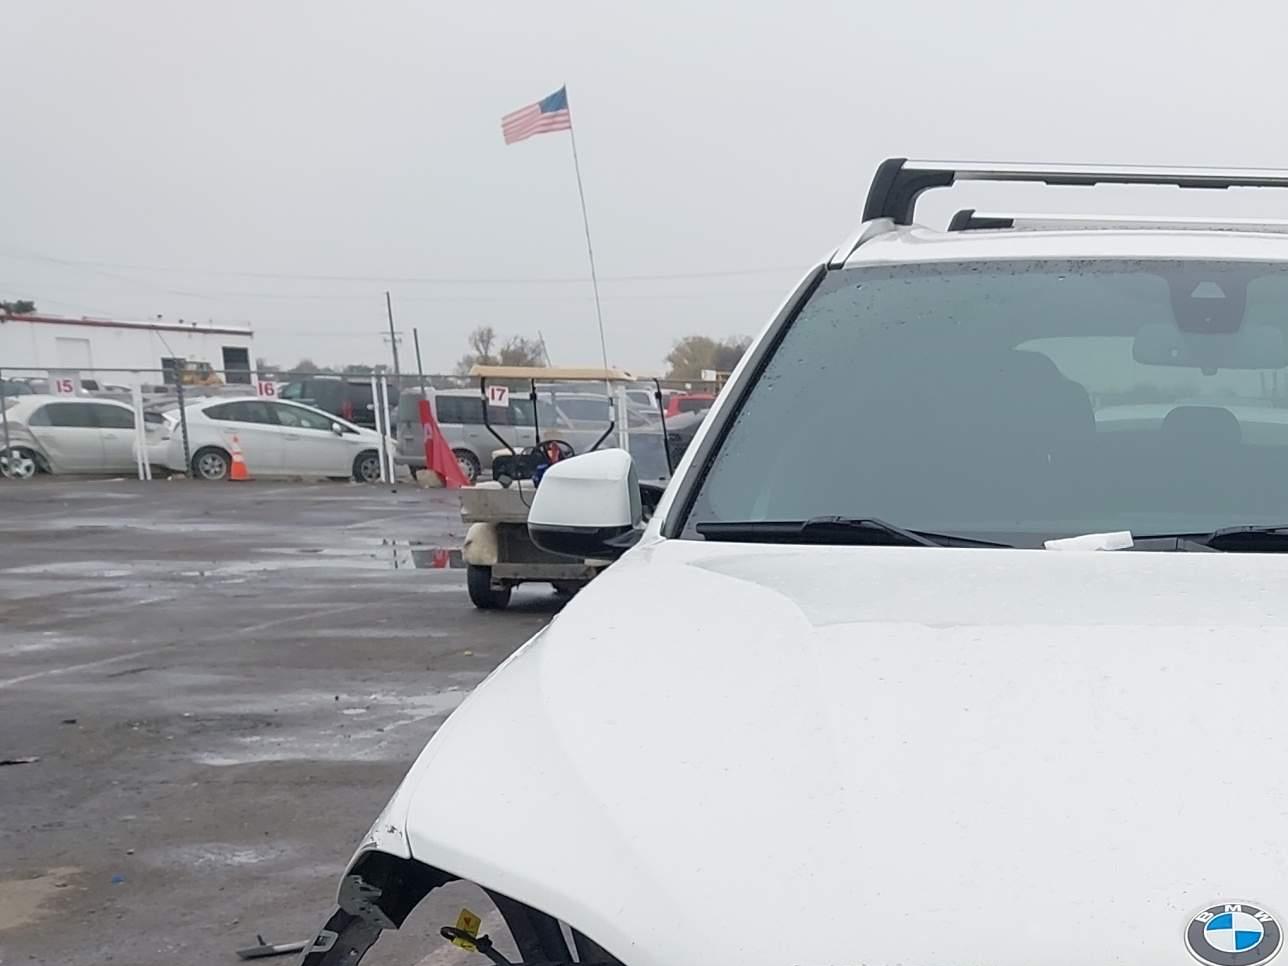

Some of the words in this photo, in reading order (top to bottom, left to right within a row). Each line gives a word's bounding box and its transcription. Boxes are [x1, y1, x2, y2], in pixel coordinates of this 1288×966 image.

[56, 379, 73, 393] 15
[258, 382, 275, 396] 16
[491, 387, 506, 401] 17
[1195, 904, 1274, 923] BMW
